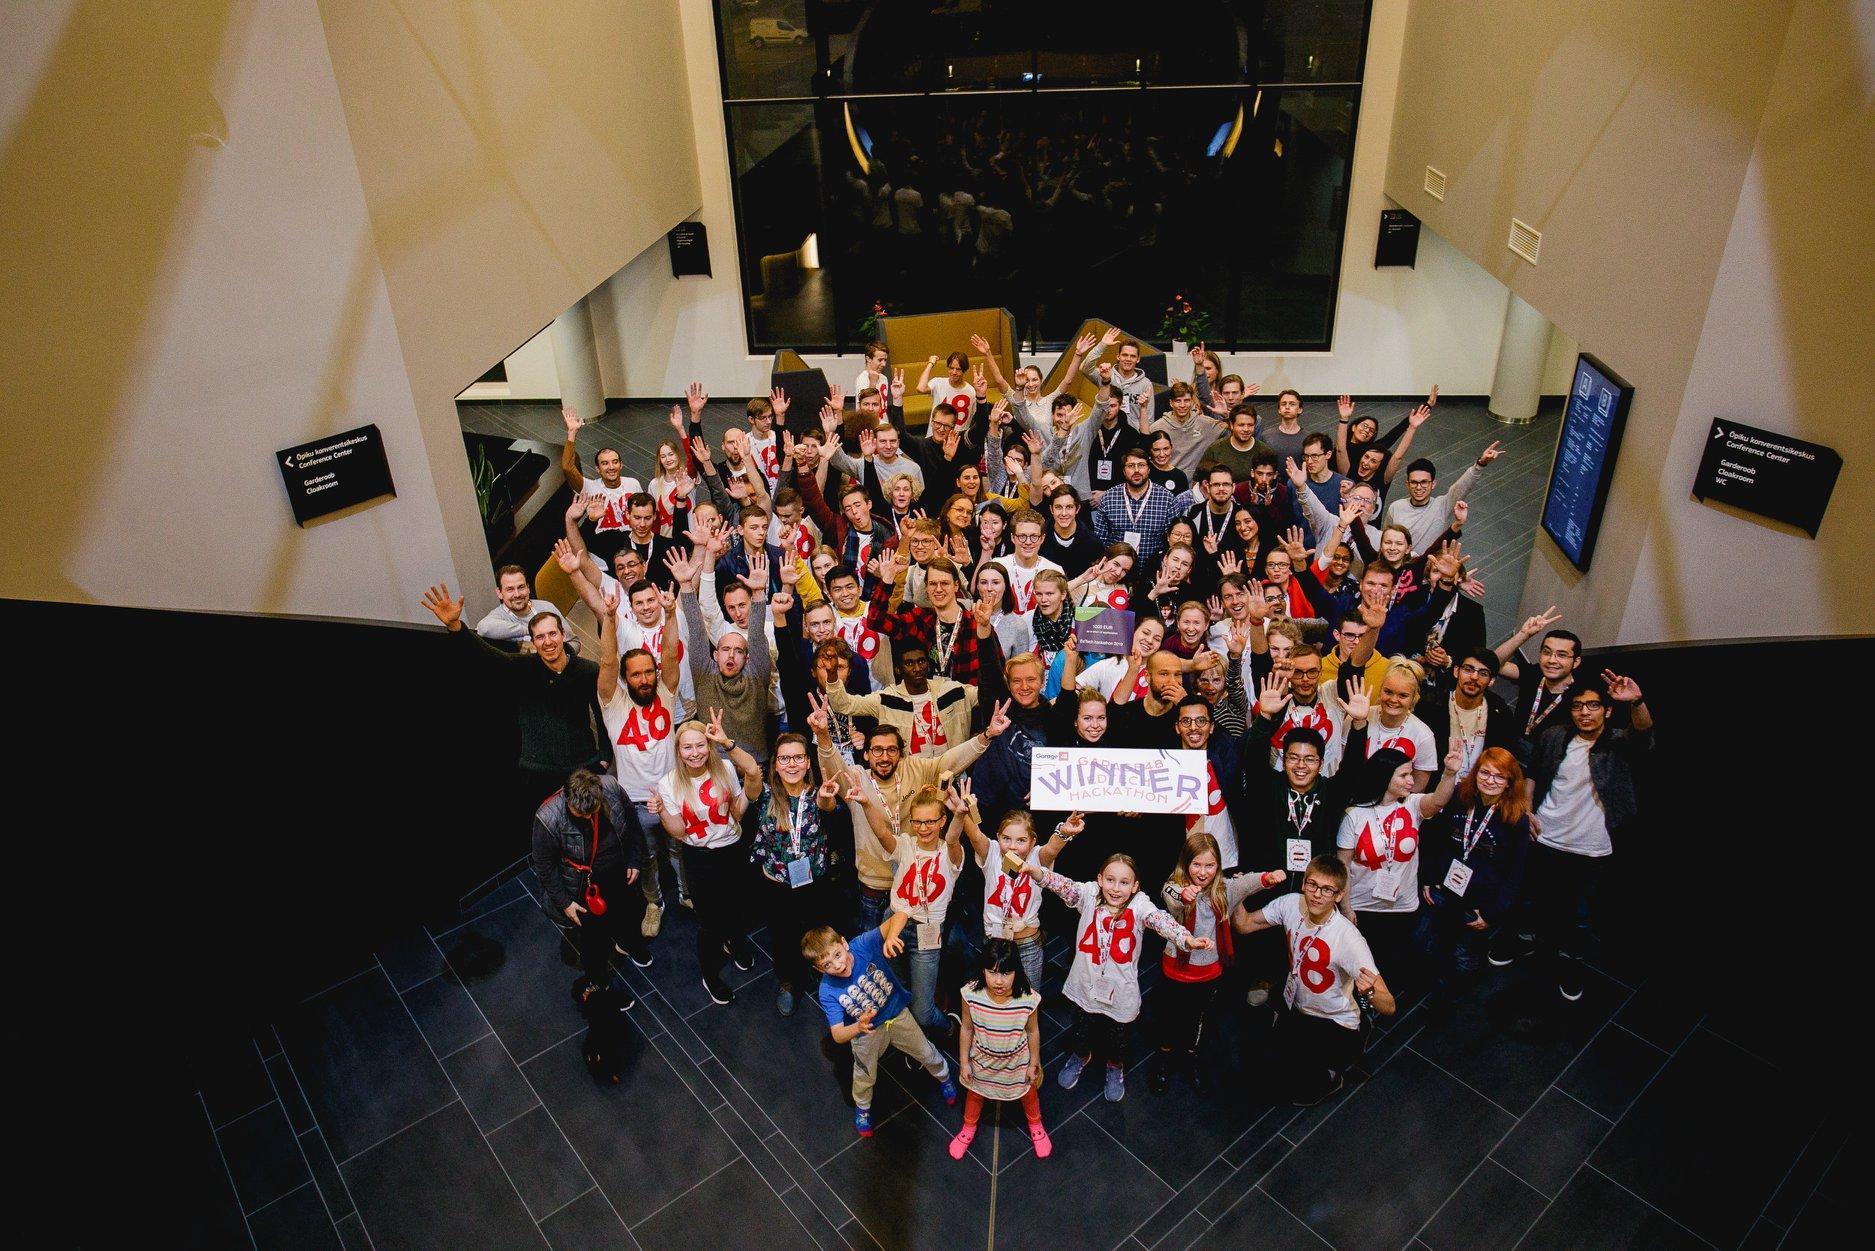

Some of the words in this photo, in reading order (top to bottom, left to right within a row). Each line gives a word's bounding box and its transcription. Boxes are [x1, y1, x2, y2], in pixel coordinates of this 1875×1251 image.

[299, 455, 332, 469] Conference
[333, 448, 353, 459] Center
[1726, 440, 1765, 457] Conference
[1766, 451, 1790, 464] Center
[1750, 437, 1815, 461] konverentsikeskus
[1717, 468, 1755, 484] Cloakroom
[1720, 459, 1756, 475] Garderoob
[303, 472, 336, 487] Garderoob
[306, 480, 339, 495] Cloakroom
[1715, 476, 1728, 486] WC
[617, 695, 671, 751] 48
[1038, 763, 1202, 800] WINNER
[1069, 786, 1168, 804] HACKATHON
[1353, 806, 1419, 872] 48
[1078, 908, 1137, 966] 48
